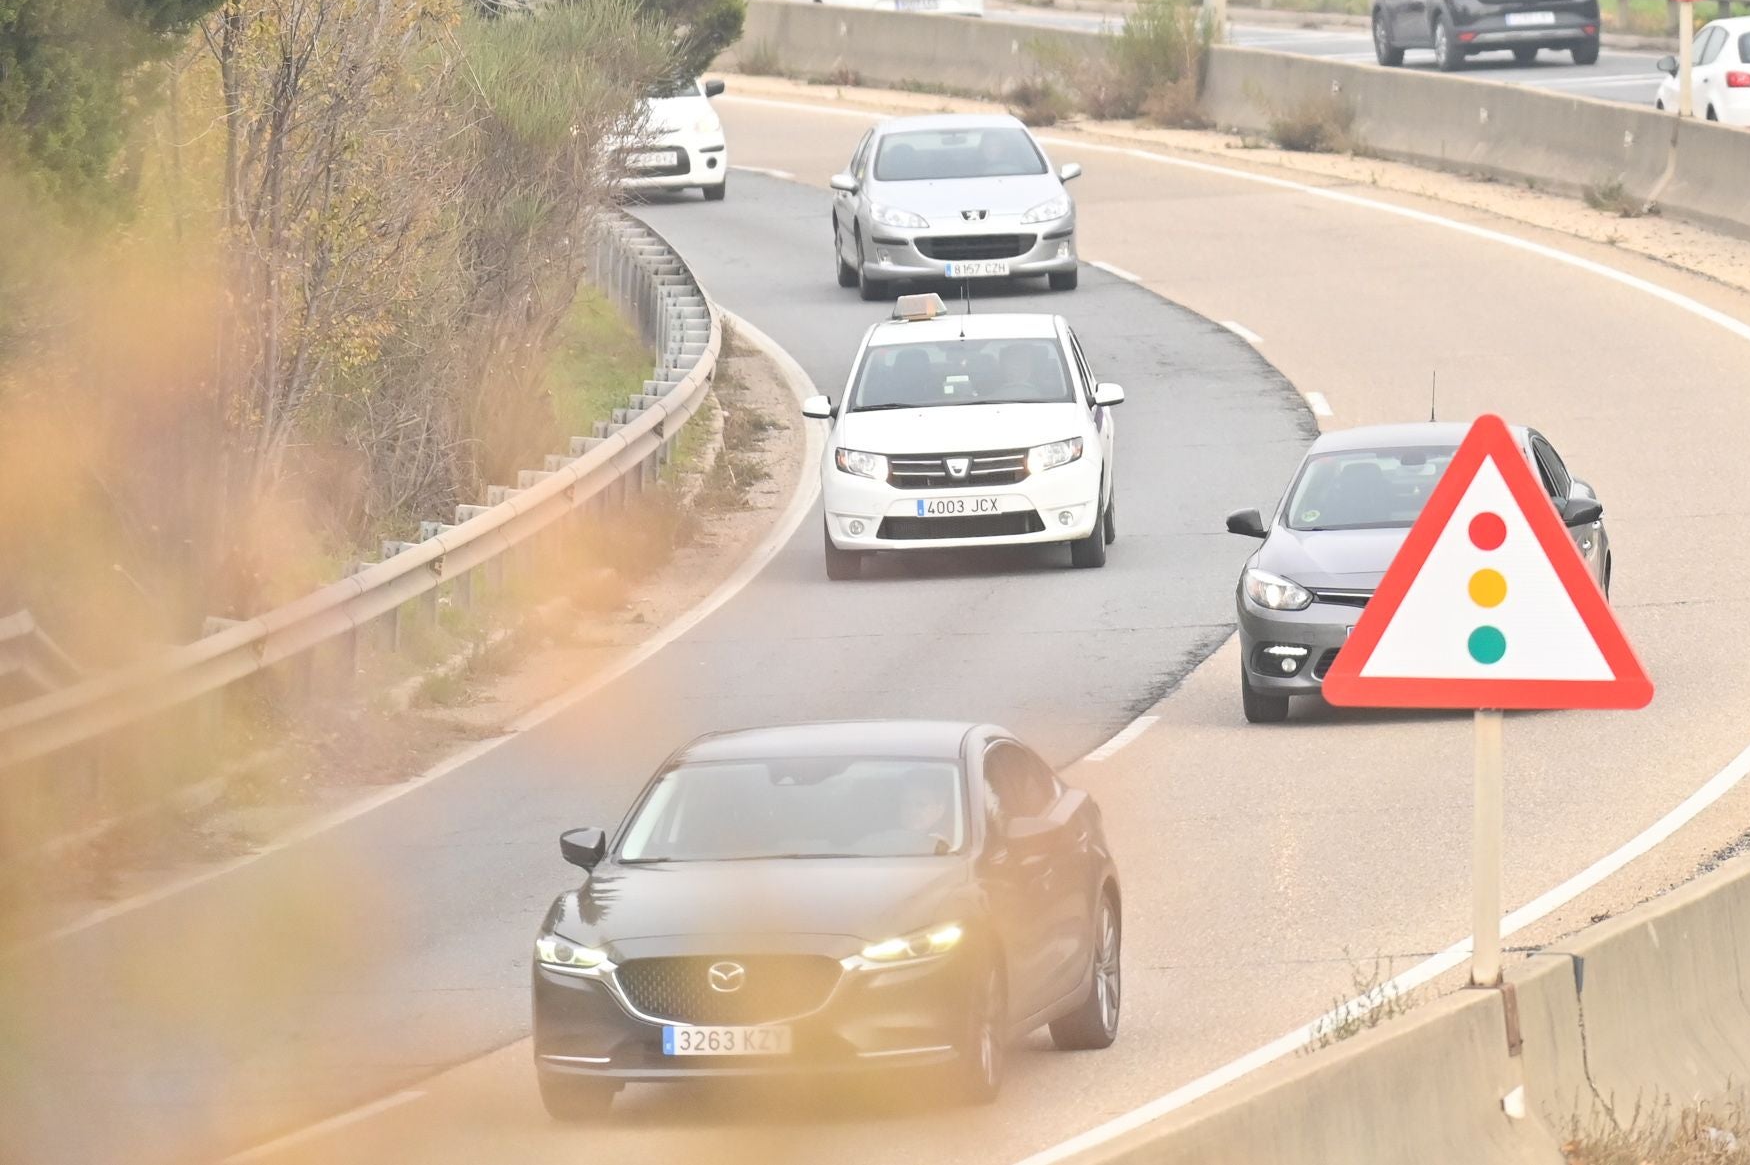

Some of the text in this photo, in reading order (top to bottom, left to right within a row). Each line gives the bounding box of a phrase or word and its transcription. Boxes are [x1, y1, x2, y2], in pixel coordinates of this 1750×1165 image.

[954, 262, 1006, 275] 8157 CZH
[928, 498, 998, 515] 4003 JCX
[680, 1030, 736, 1051] 3263
